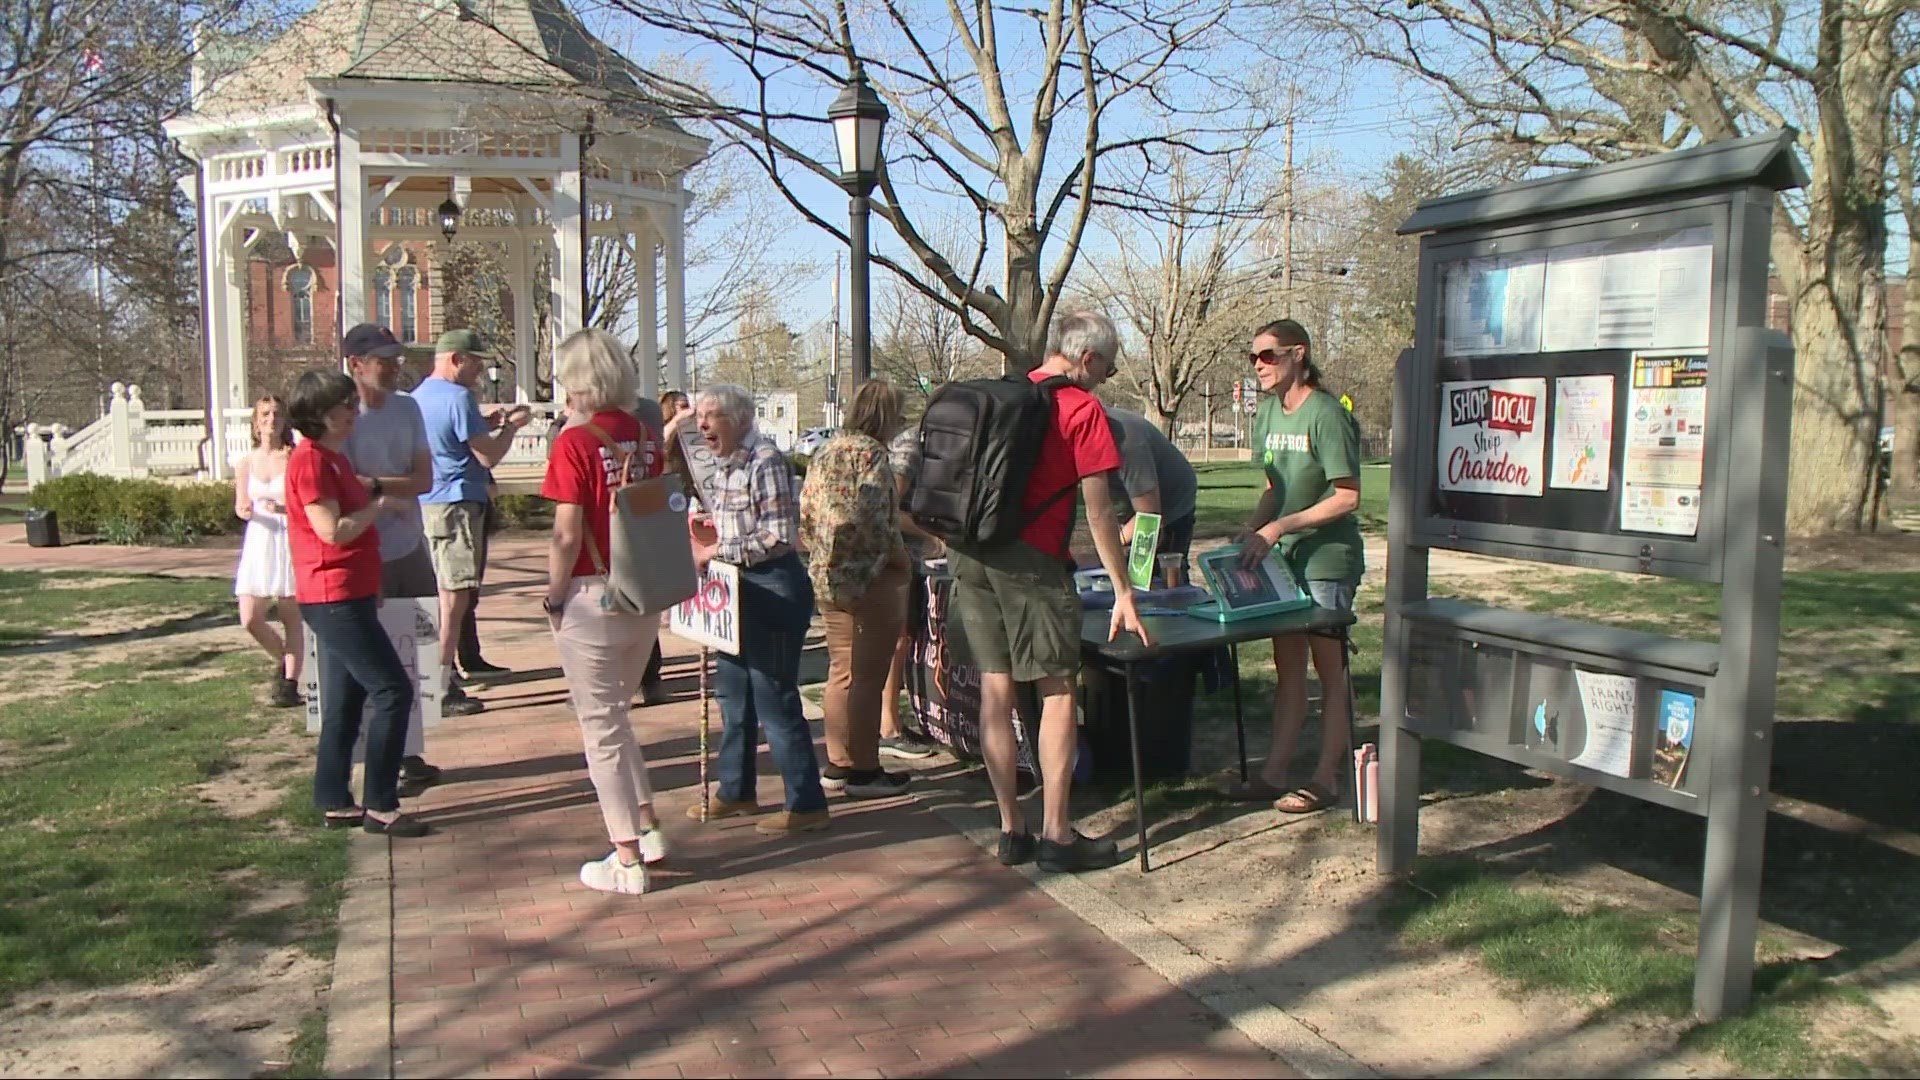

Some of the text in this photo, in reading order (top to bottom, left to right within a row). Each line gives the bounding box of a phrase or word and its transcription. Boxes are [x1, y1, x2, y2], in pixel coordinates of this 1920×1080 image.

[1453, 391, 1488, 422] SHOP
[1491, 395, 1532, 425] LOCAL
[1474, 431, 1501, 456] Shop
[1448, 446, 1531, 486] Chardon
[1591, 686, 1632, 702] TRANS
